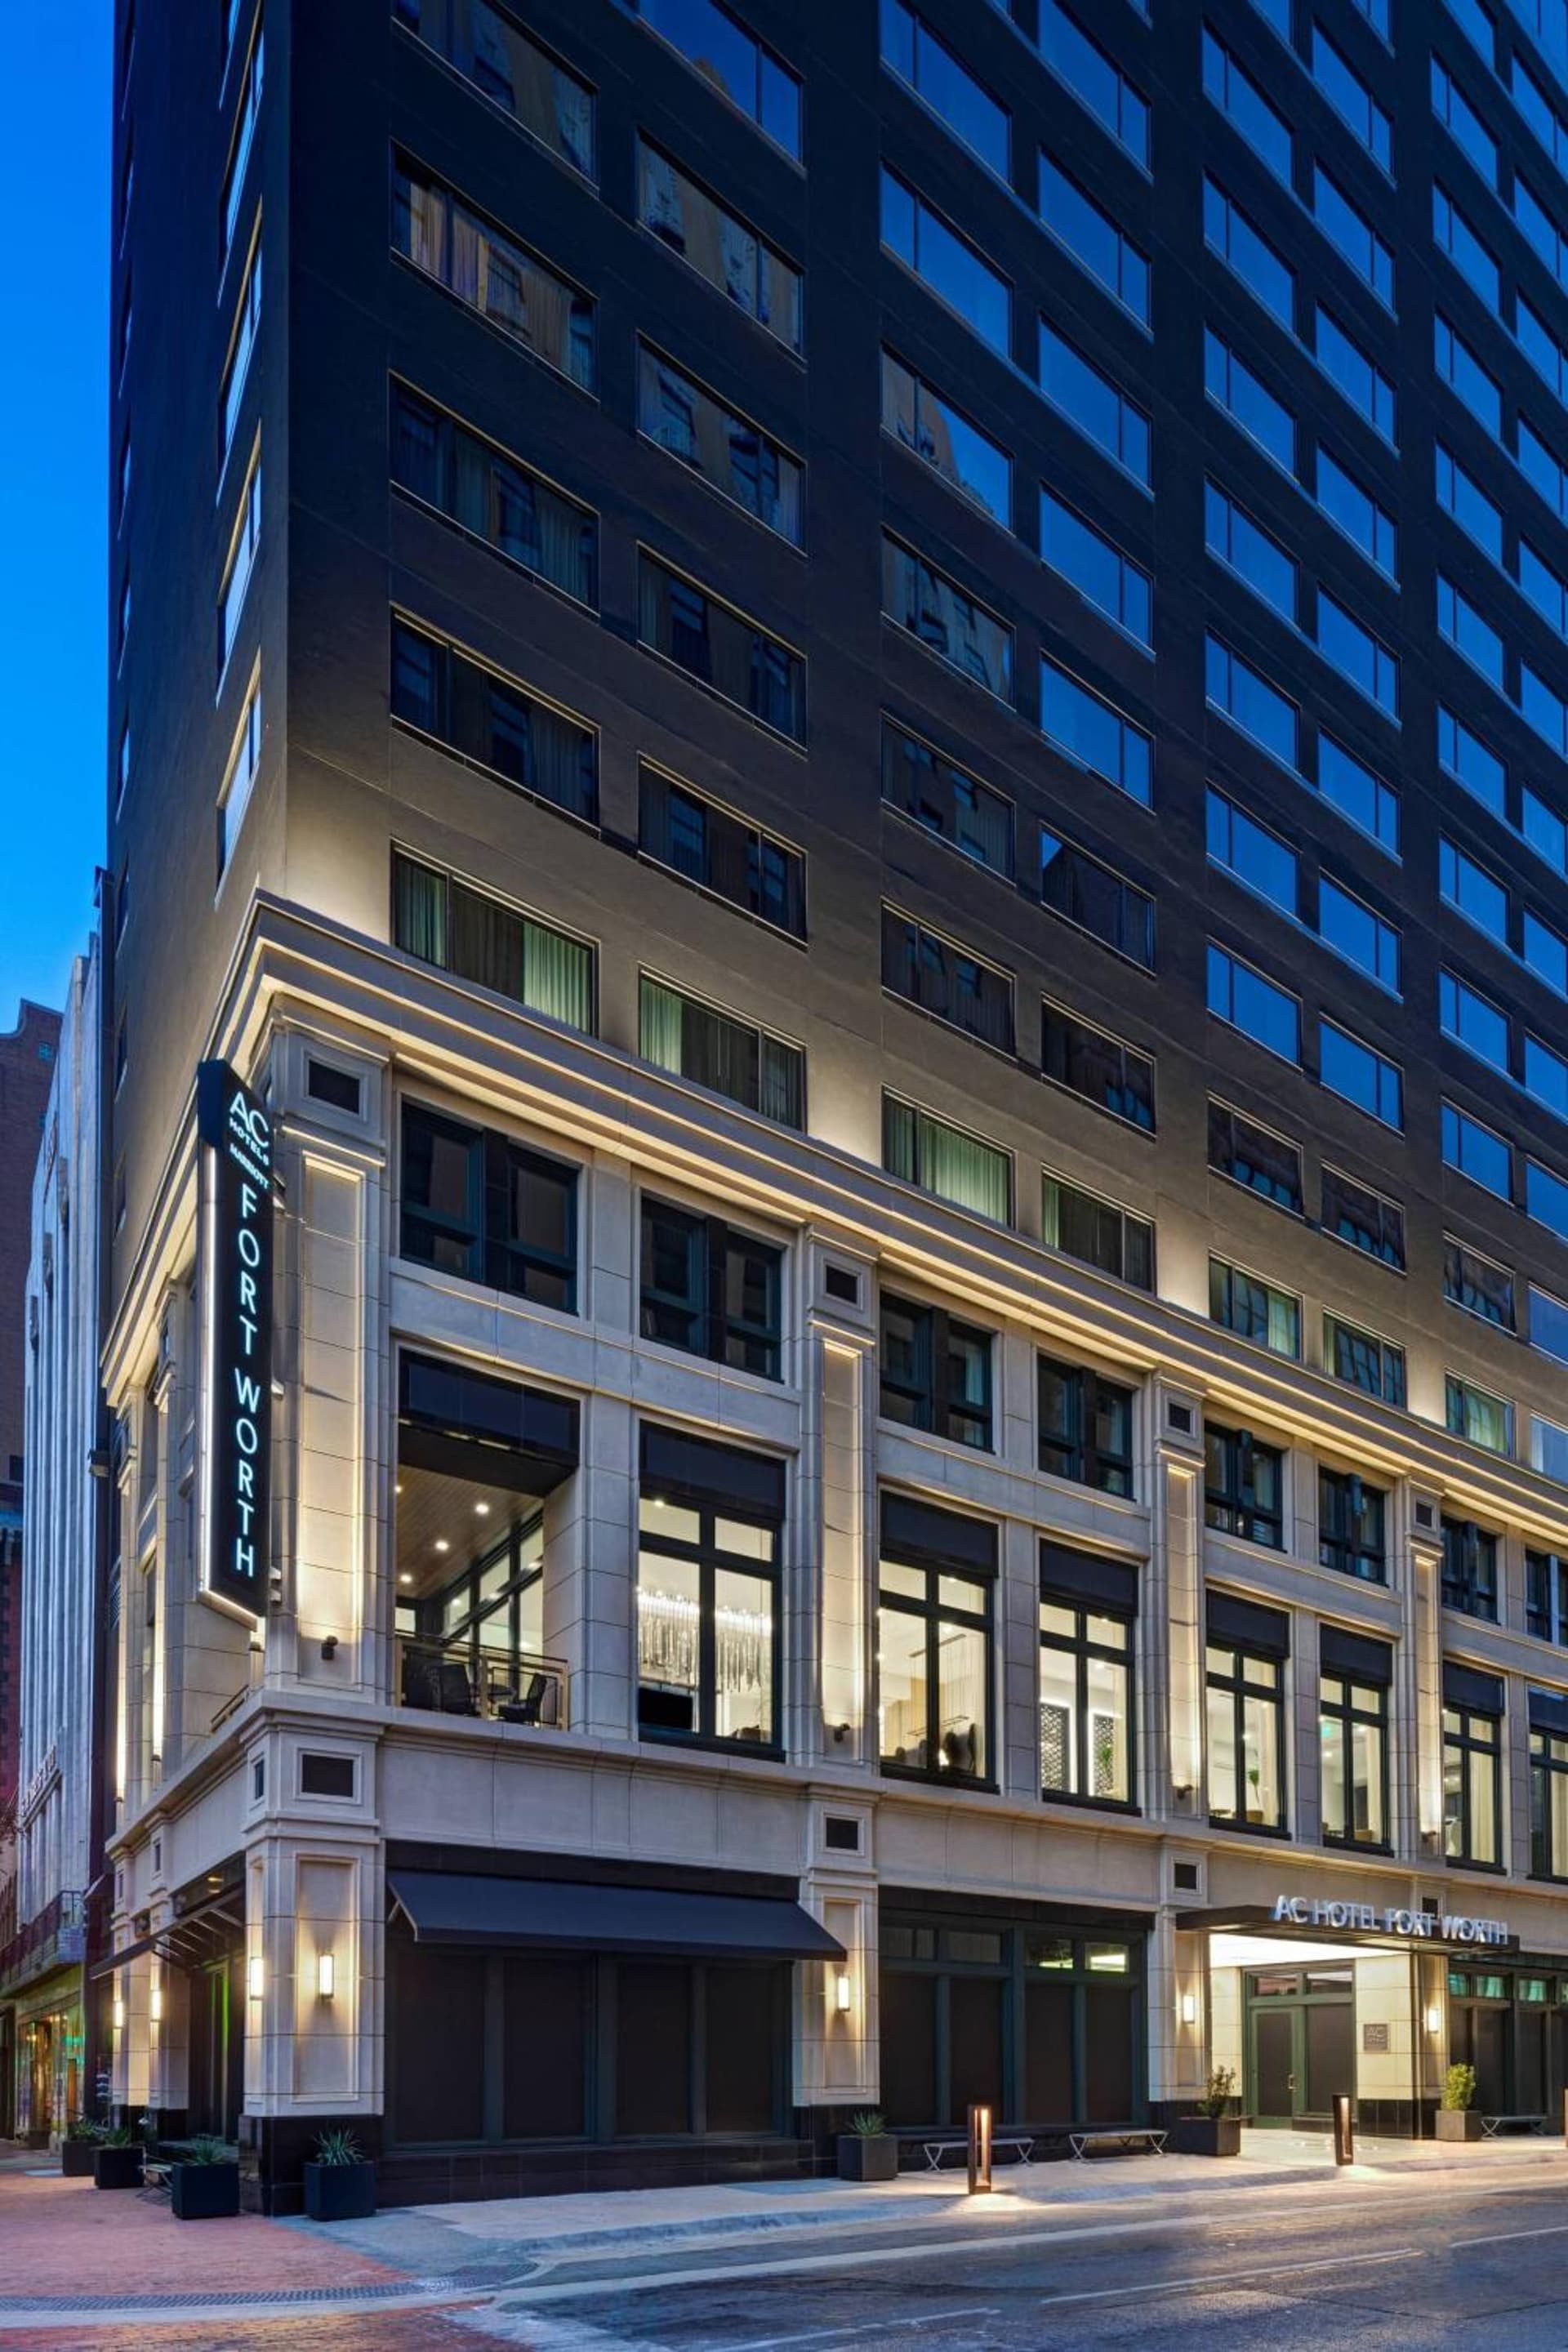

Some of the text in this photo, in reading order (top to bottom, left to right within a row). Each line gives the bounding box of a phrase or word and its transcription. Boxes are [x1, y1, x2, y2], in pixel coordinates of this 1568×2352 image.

[229, 1091, 270, 1147] AC
[229, 1117, 270, 1166] HOTELS
[234, 1183, 261, 1577] FORT WORTH
[1273, 1895, 1508, 1944] AC HOTEL FORT WORTH
